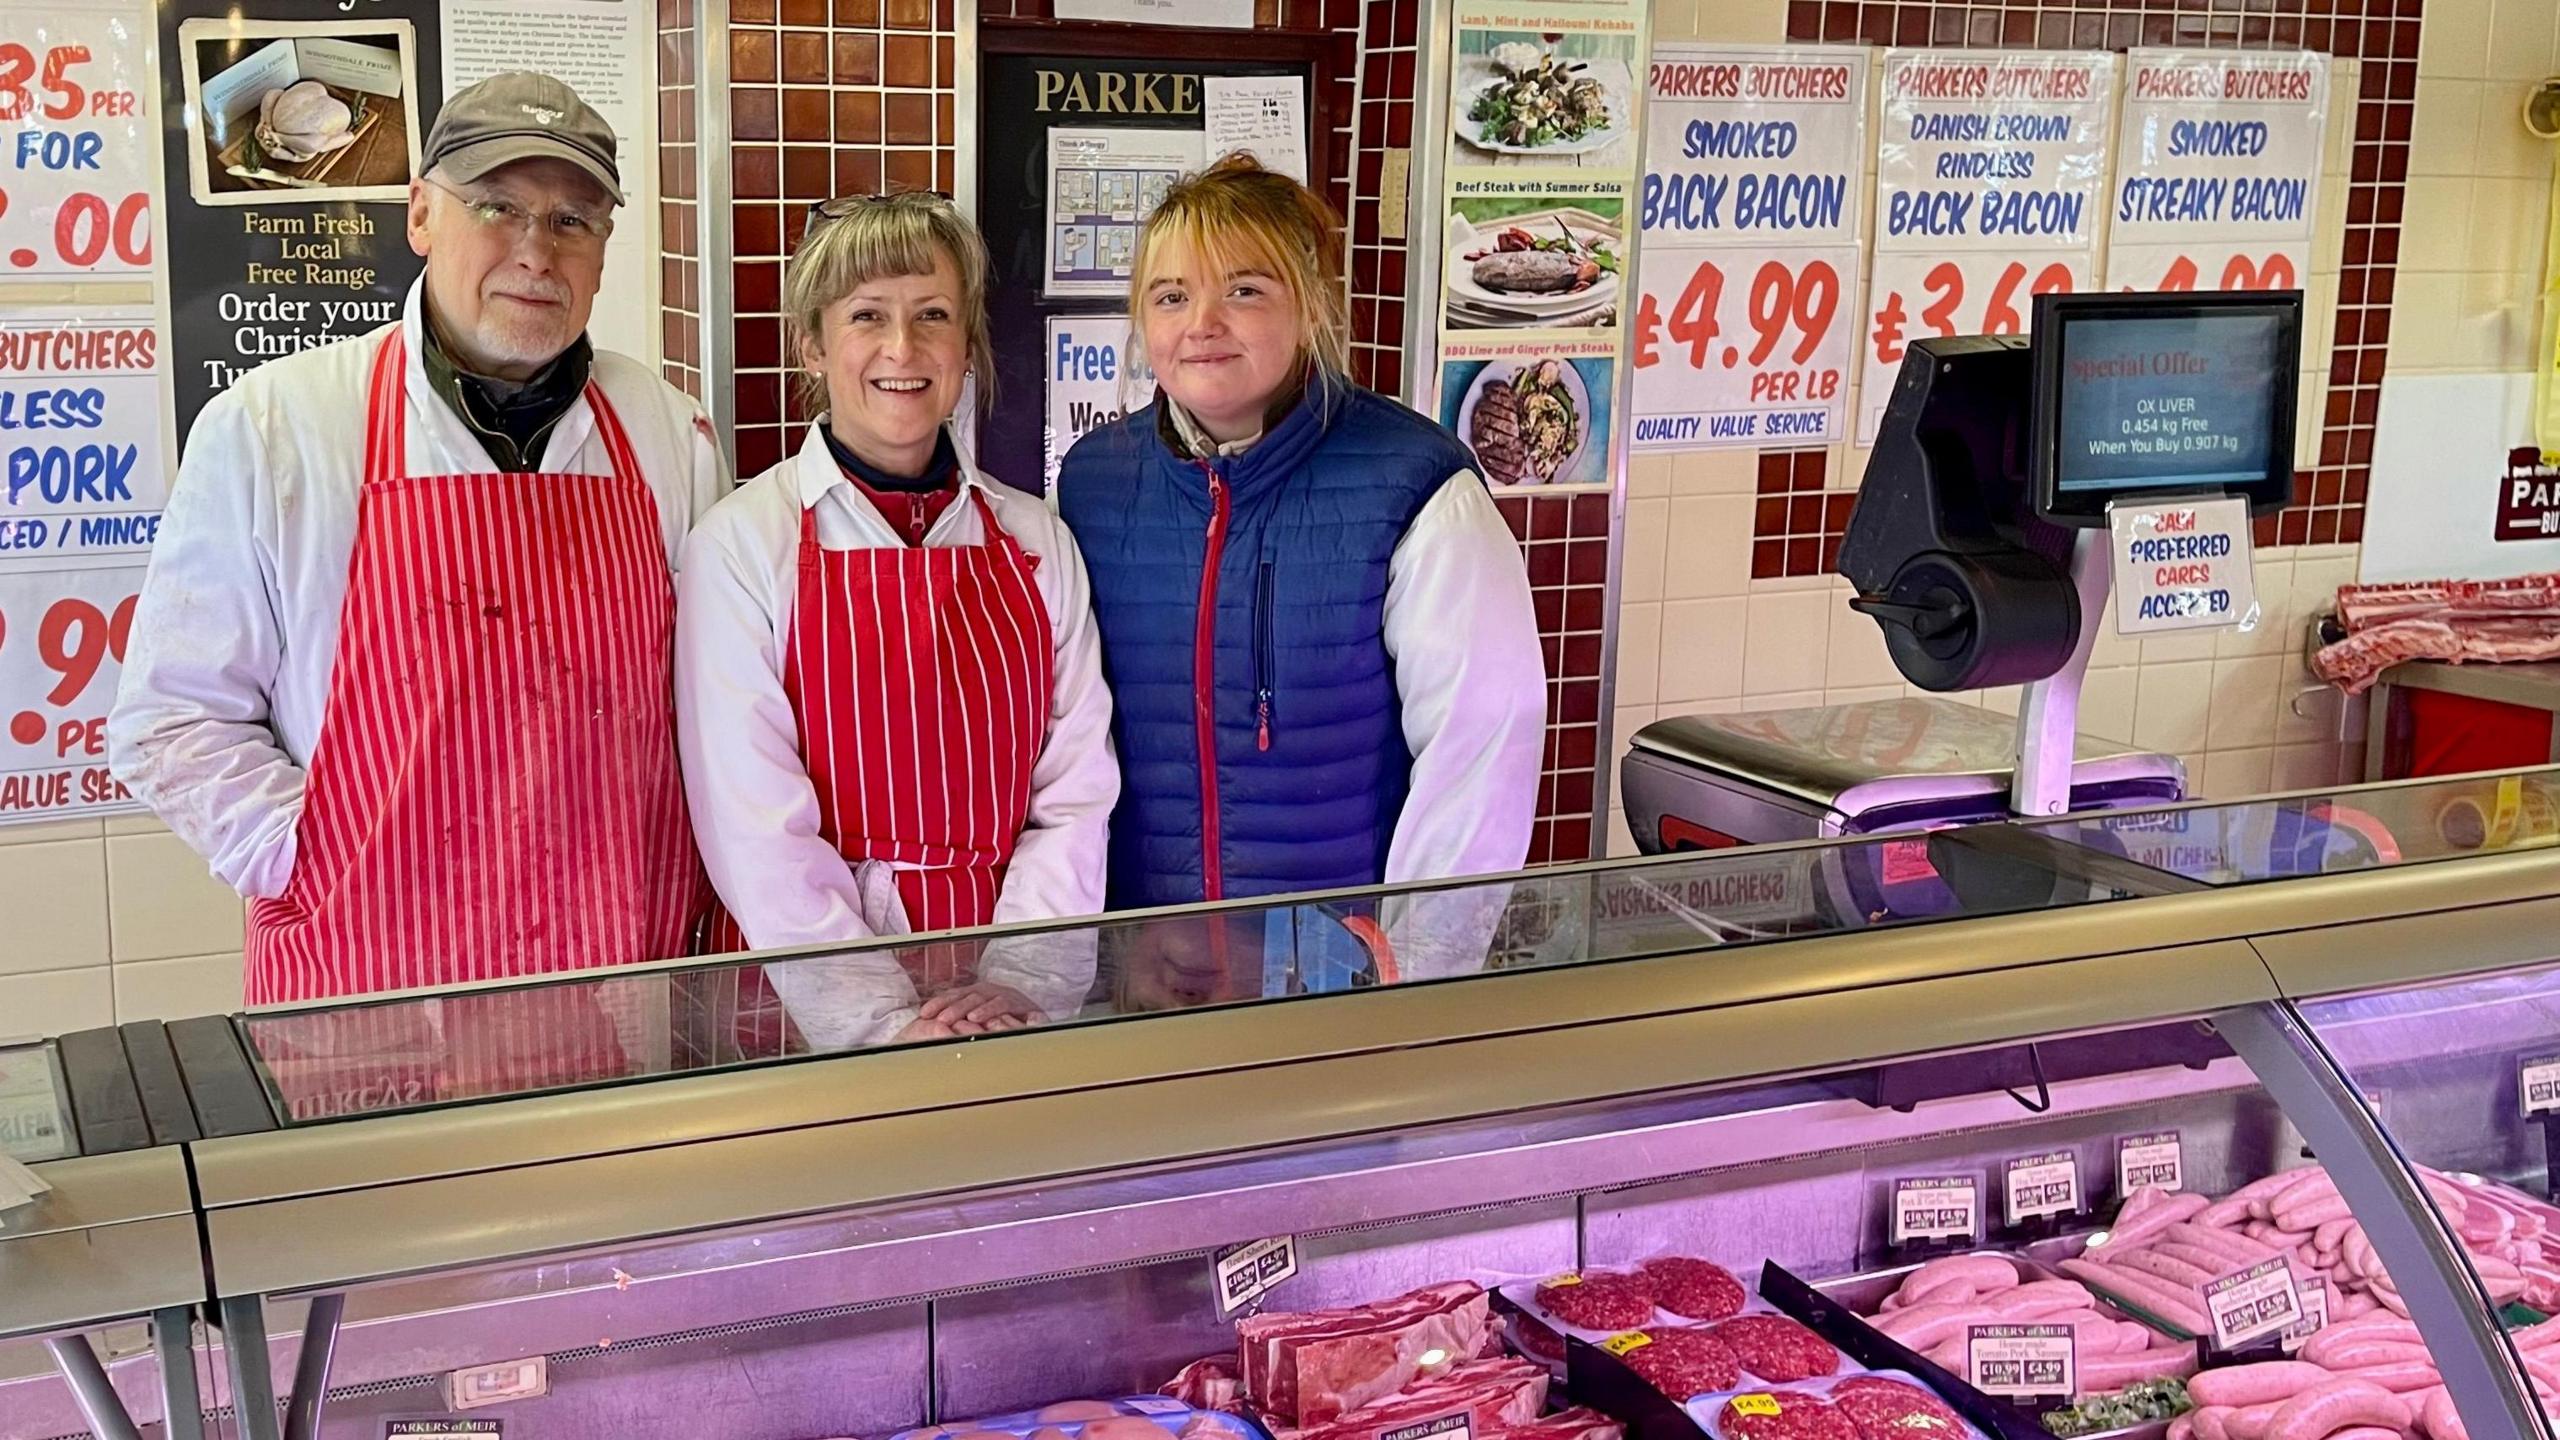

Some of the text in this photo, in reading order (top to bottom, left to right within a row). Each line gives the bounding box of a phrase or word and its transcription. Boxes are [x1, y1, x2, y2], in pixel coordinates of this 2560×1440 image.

[1460, 15, 1635, 31] Lamb, Mint and Halloumi Kebabs
[1650, 64, 1848, 99] PARKERS BUTCHERS
[1897, 65, 2091, 99] PARKERS BUTCHERS
[2136, 67, 2311, 100] PARKERS BUTCHERS
[91, 91, 136, 117] PER
[1683, 119, 1798, 159] SMOKED
[1911, 113, 2072, 142] DANISH CROWN
[2168, 119, 2268, 157] SMOKED
[16, 131, 103, 170] FOR
[1935, 151, 2035, 179] RINDLESS
[1455, 181, 1622, 194] Beef Steak with Summer Salsa
[1641, 173, 1847, 230] BACK BACON
[2119, 177, 2307, 222] STREAKY BACON
[243, 211, 375, 236] Farm Fresh
[1887, 190, 2084, 236] BACK BACON
[280, 238, 341, 260] Local
[247, 263, 376, 290] Free Range
[218, 294, 396, 332] Order your
[1634, 260, 1840, 370] £4.99
[1057, 333, 1116, 381] Free
[1445, 342, 1615, 357] BBQ Lime and Ginger Pork Steaks
[2070, 351, 2210, 384] Special Offer
[1750, 369, 1839, 402] PER LB
[2136, 397, 2195, 415] OX LIVER
[1635, 411, 1827, 441] QUALITY VALUE SERVICE
[2121, 416, 2208, 435] 0.454 kg Free
[2089, 435, 2238, 456] When You Buy 0.907 kg
[8, 444, 137, 503] PORK
[2130, 533, 2231, 564] PREFERRED
[1900, 1179, 1939, 1189] PARKERS
[1225, 1253, 1245, 1270] Beef
[1246, 1241, 1269, 1258] Short
[1974, 1326, 2025, 1337] PARKERS
[2026, 1326, 2039, 1336] of
[1981, 1361, 2061, 1376] £10.99 £4.99
[1737, 1399, 1776, 1411] £4.99
[392, 1421, 497, 1433] PARKERS of MEIR
[1384, 1415, 1466, 1440] PARKERS of MEIR
